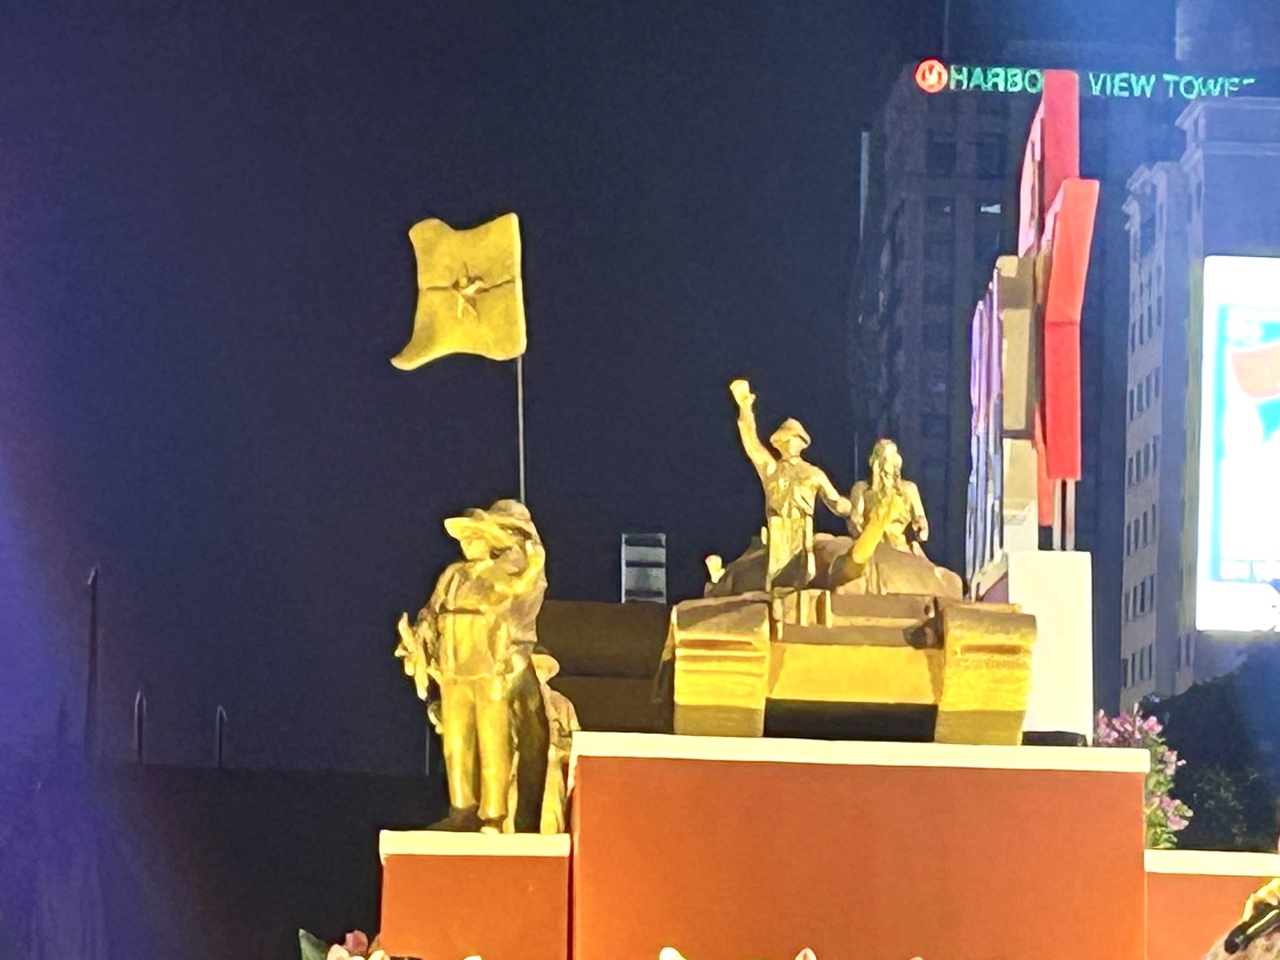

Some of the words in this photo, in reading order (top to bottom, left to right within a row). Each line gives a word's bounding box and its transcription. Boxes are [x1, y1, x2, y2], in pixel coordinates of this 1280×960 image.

[950, 65, 1043, 94] HARBO
[1089, 72, 1156, 98] VIEW
[1163, 73, 1255, 99] TOWE
